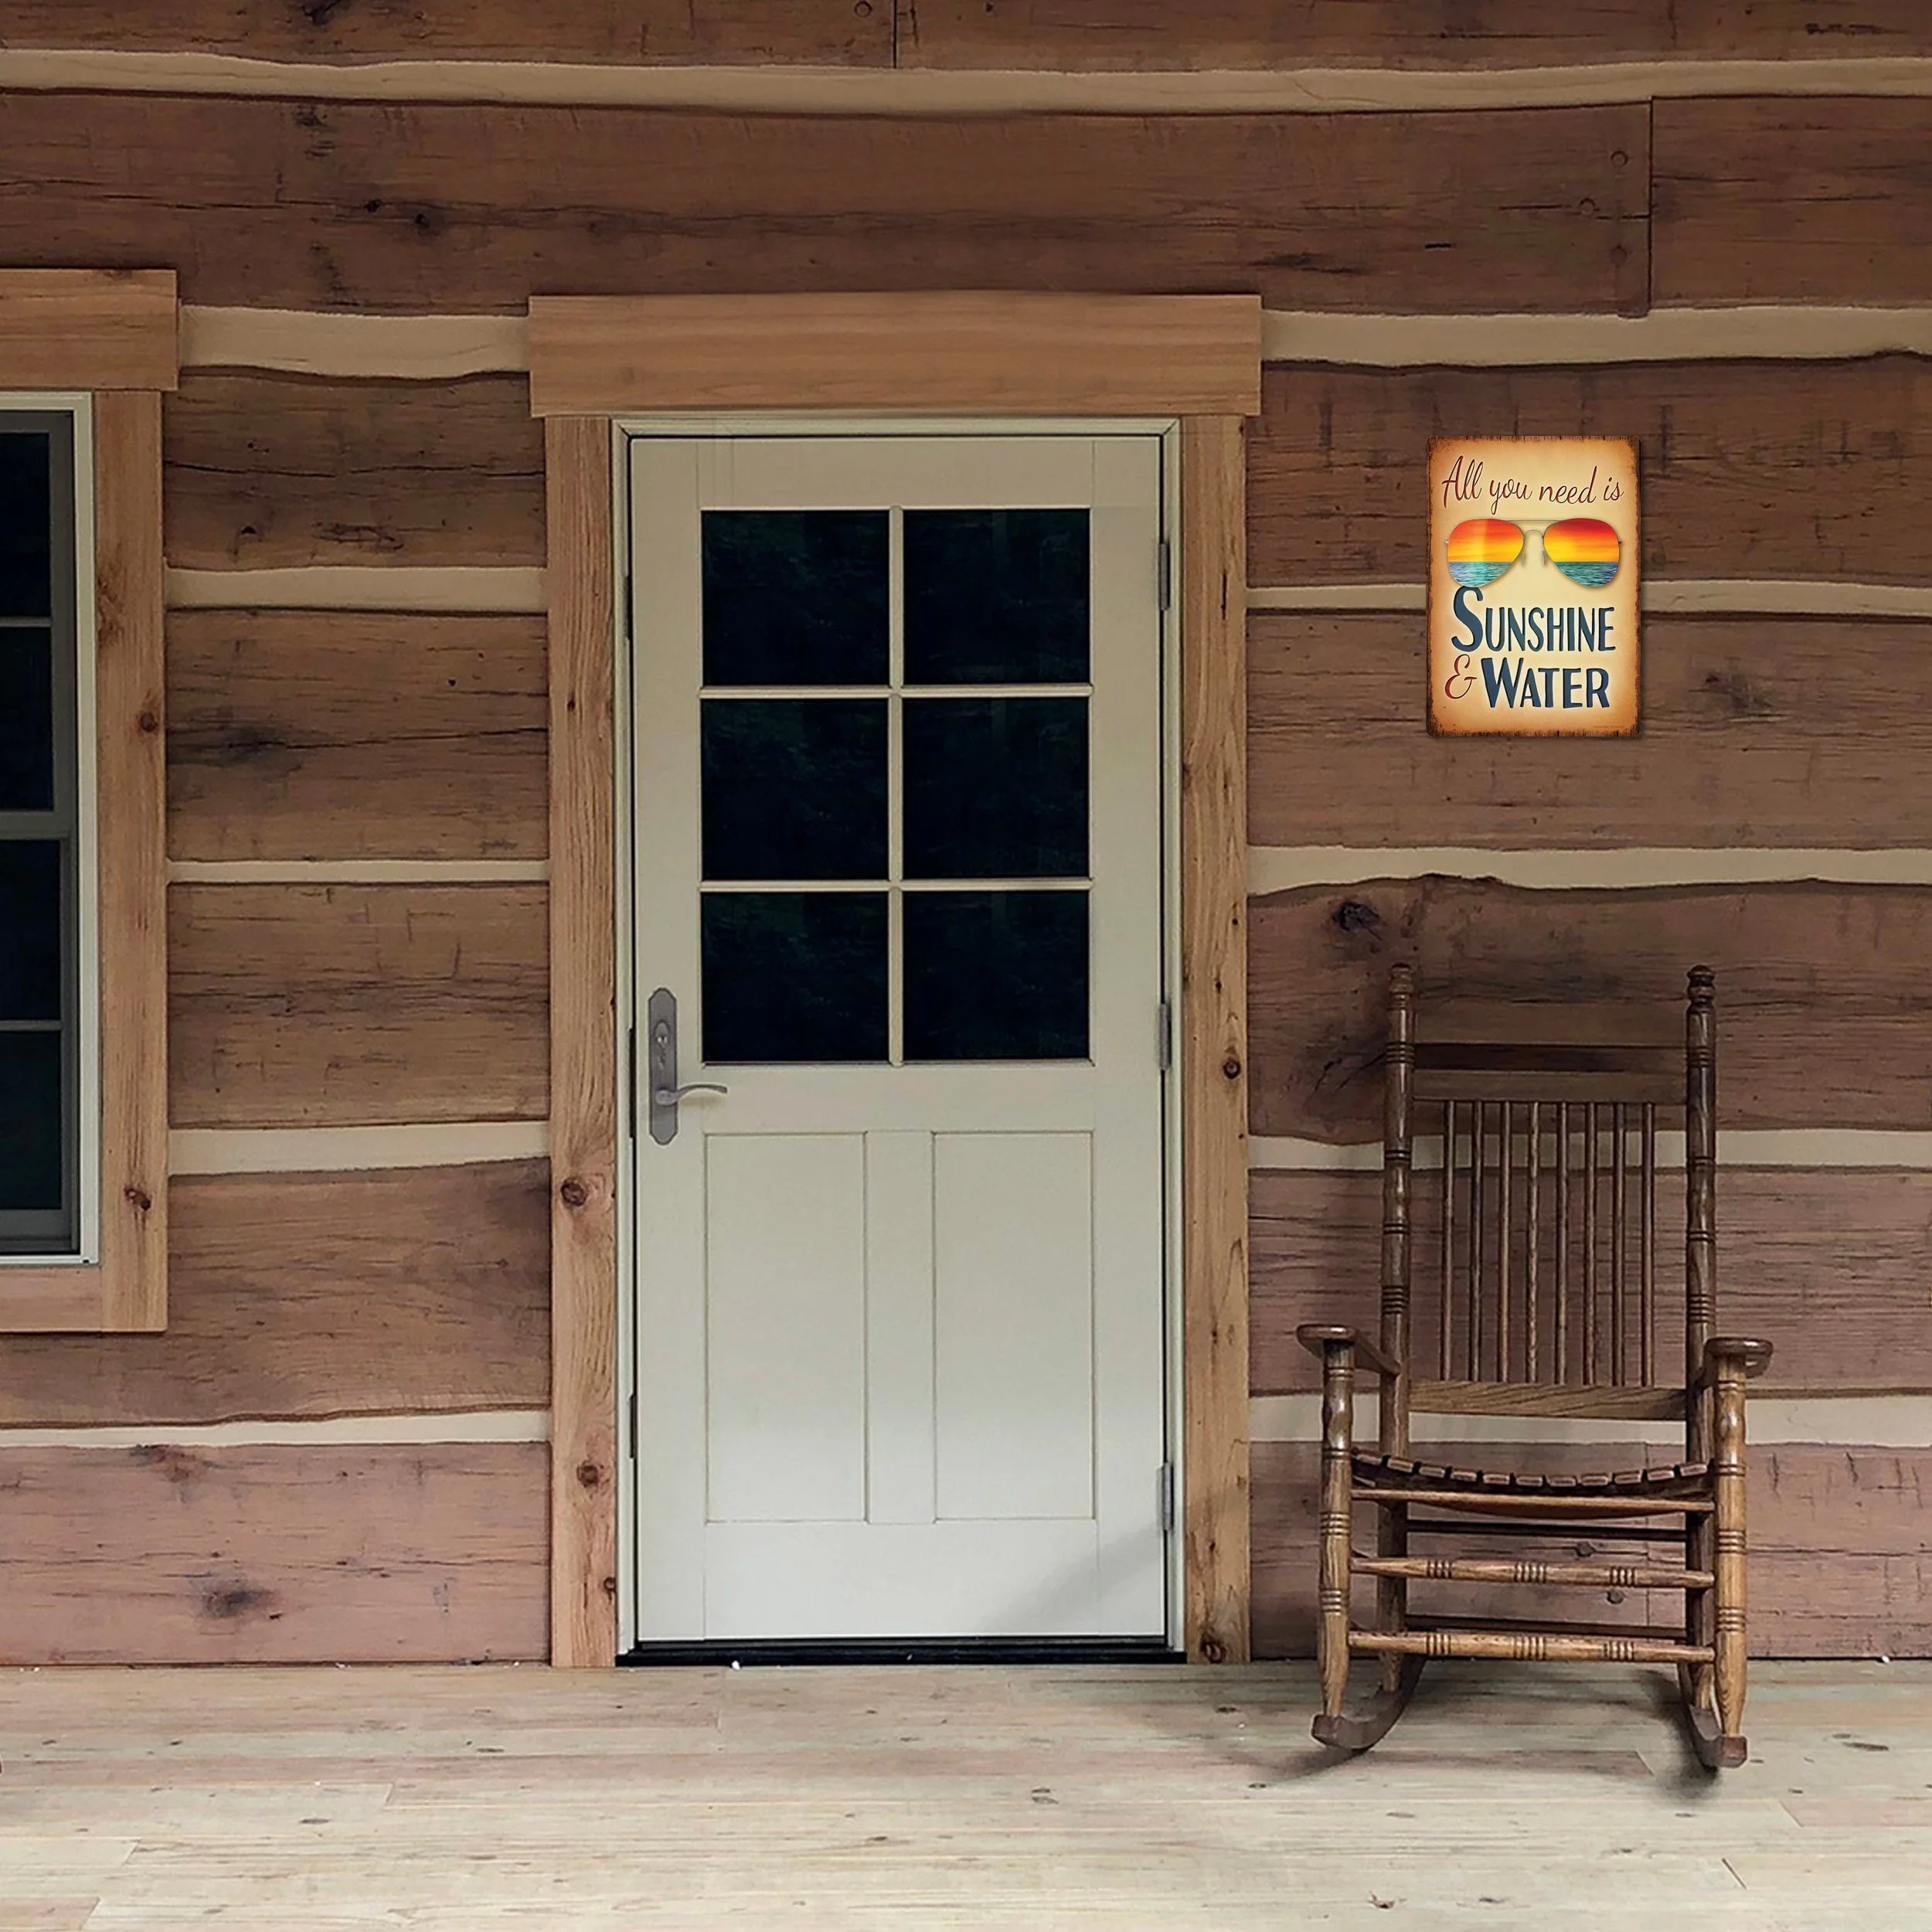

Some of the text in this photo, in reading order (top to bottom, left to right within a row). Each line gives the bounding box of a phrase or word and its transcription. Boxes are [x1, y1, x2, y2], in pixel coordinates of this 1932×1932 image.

[1442, 455, 1624, 515] All you need is
[1451, 586, 1616, 652] SUNSHINE
[1444, 654, 1611, 709] & WATER
